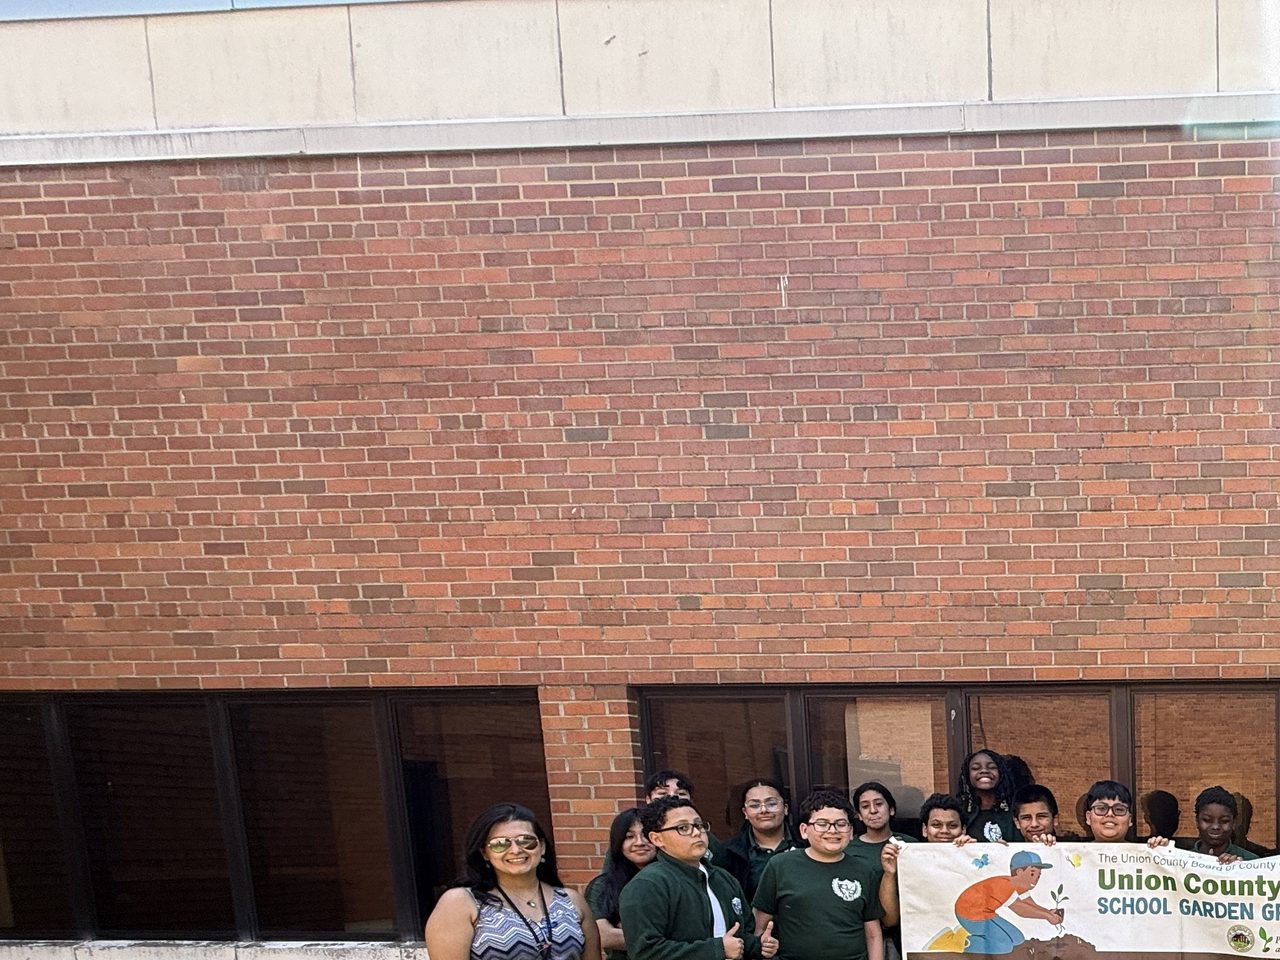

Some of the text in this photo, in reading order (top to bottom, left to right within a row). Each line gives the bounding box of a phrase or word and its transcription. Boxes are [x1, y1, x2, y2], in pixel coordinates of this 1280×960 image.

[1098, 853, 1118, 864] The
[1121, 853, 1151, 864] Union
[1153, 855, 1188, 869] County
[1191, 860, 1223, 872] Board
[1239, 860, 1276, 872] County
[1098, 868, 1177, 891] Union
[1097, 897, 1172, 915] SCHOOL
[1179, 899, 1254, 920] GARDEN
